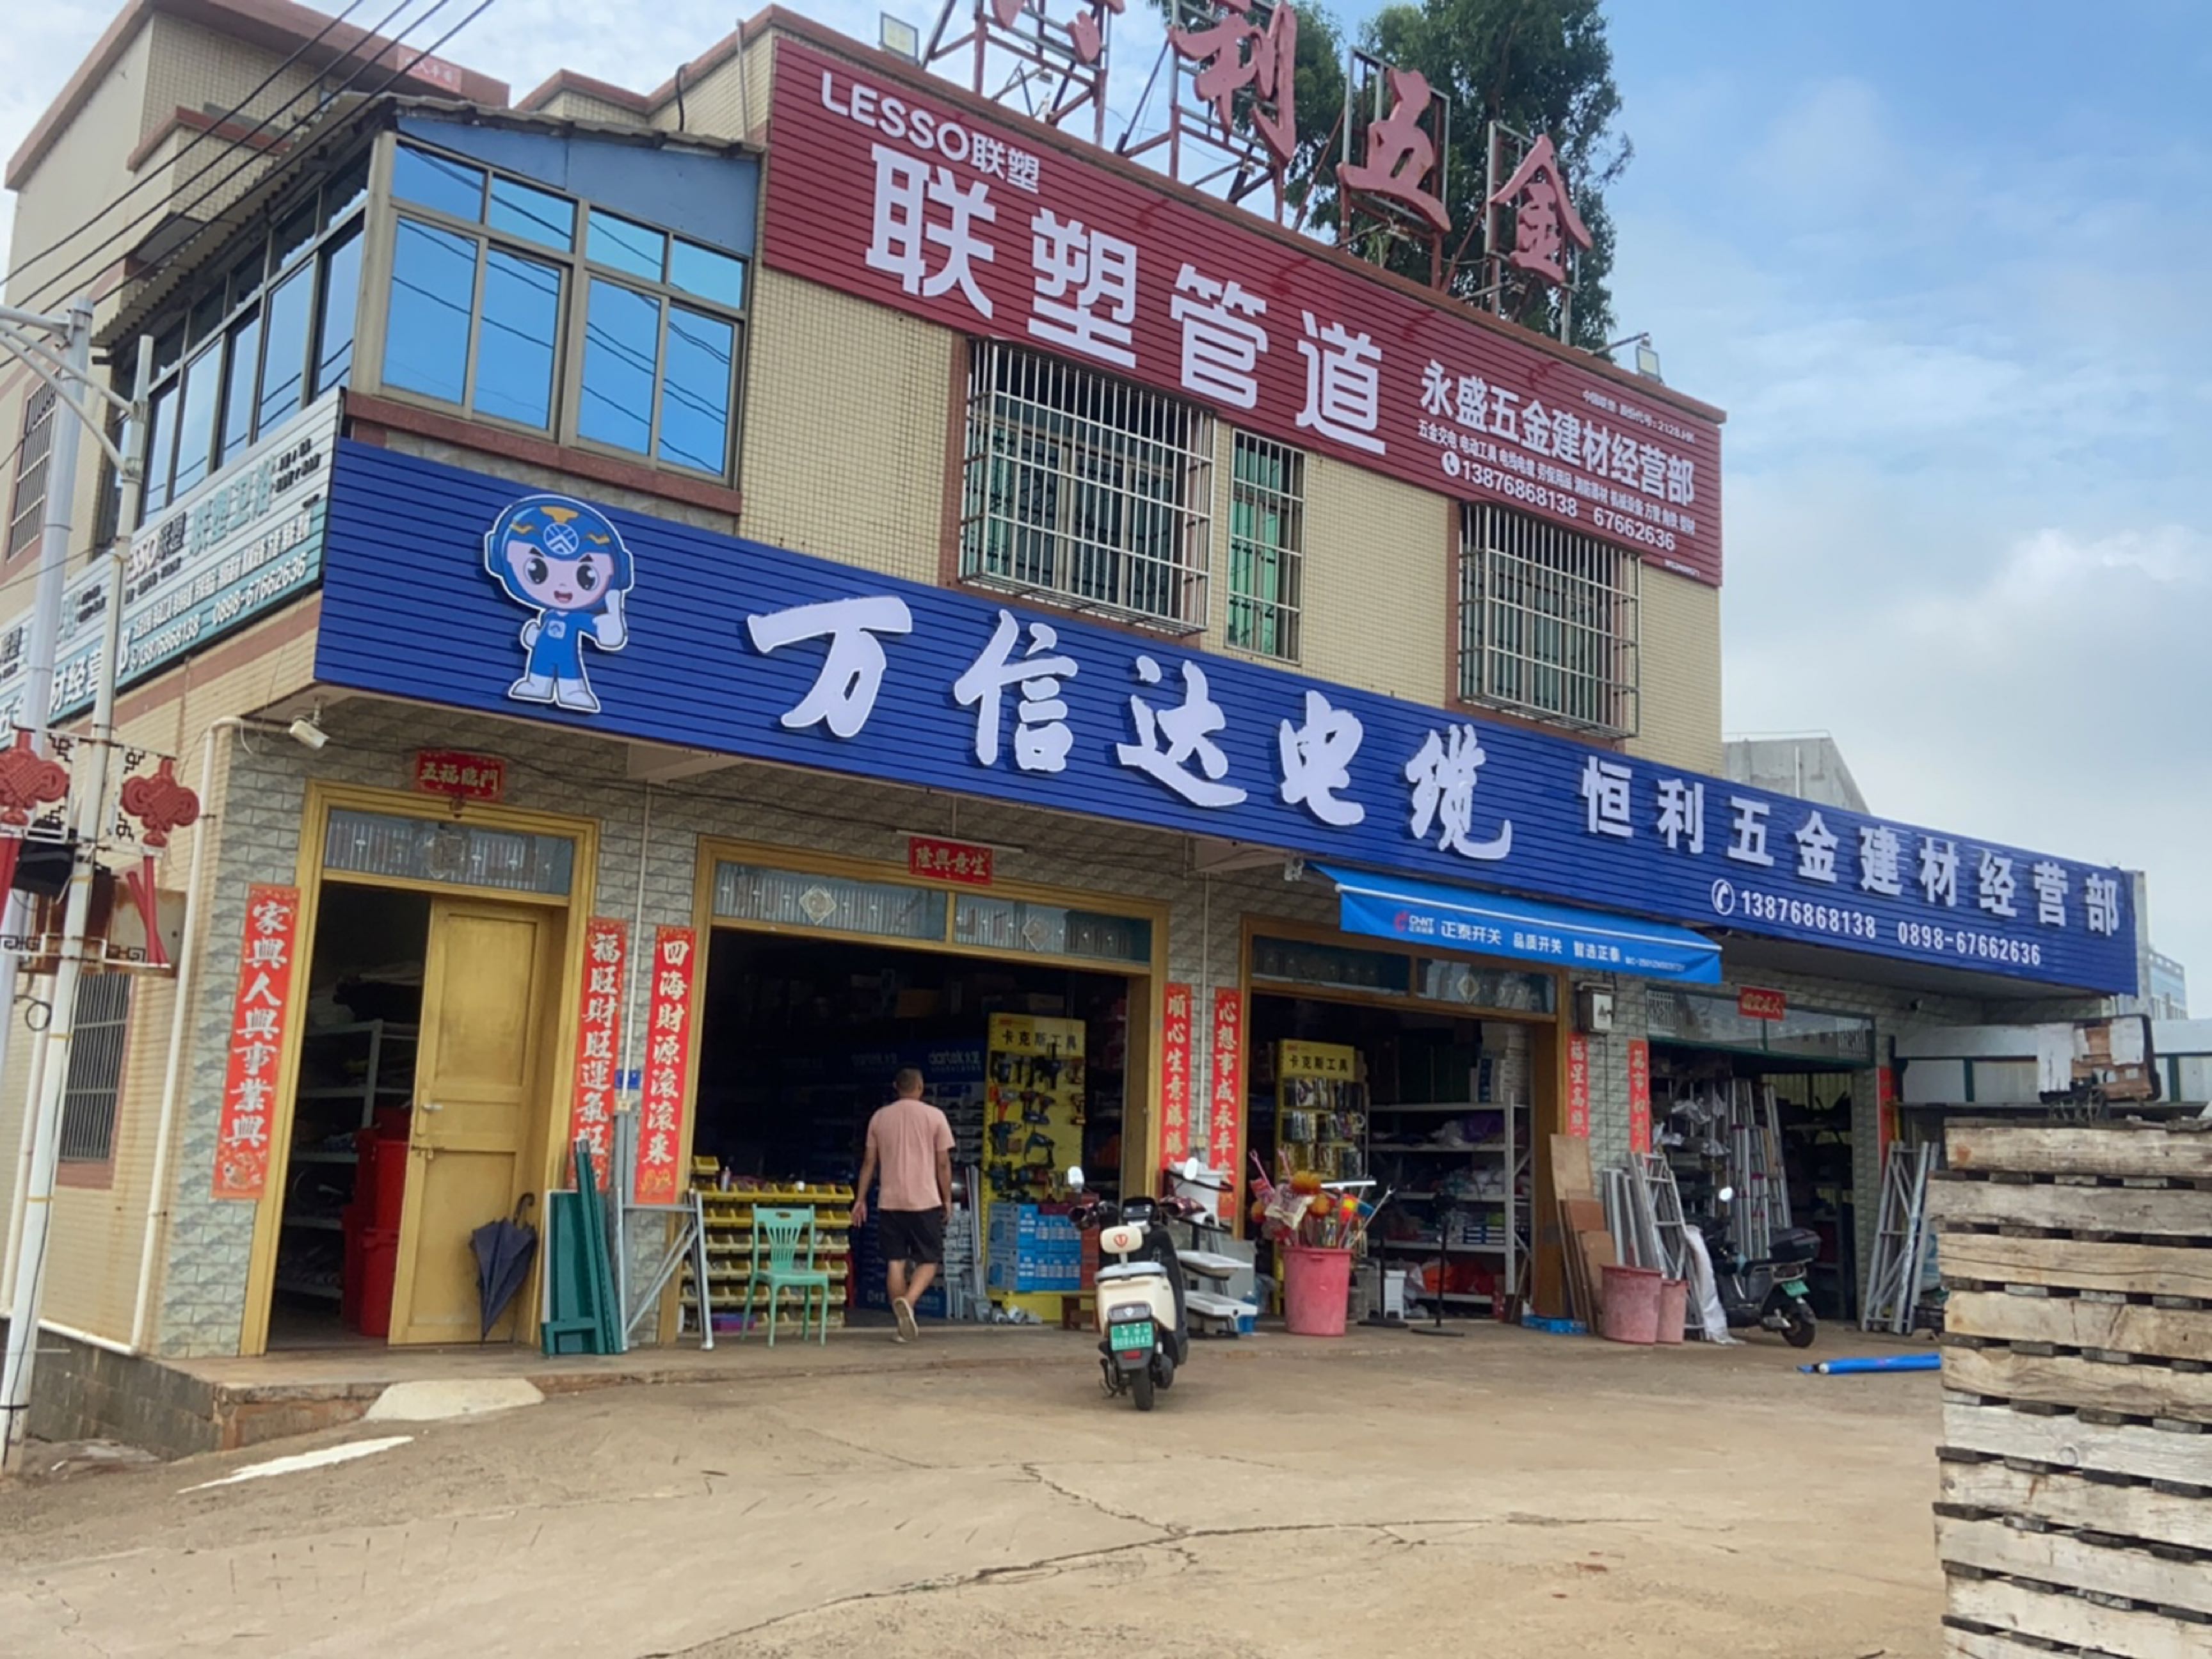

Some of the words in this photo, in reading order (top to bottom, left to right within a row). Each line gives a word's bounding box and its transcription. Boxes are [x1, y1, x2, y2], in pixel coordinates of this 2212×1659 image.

[822, 70, 1039, 195] LESSO联塑
[865, 142, 1385, 456] 联塑管道
[1420, 358, 1695, 507] 永盛五金建材经营部
[1463, 460, 1578, 518] 13876868138
[1593, 506, 1676, 551] 67662636
[745, 595, 1513, 861] 万信达电缆
[1582, 755, 2120, 937] 恒利五金建材经营部
[1441, 920, 1502, 945] 正泰开关
[1513, 931, 1562, 954] 品质开关
[1741, 890, 1876, 940] 13876868138
[1897, 920, 2042, 966] 0898-67662636
